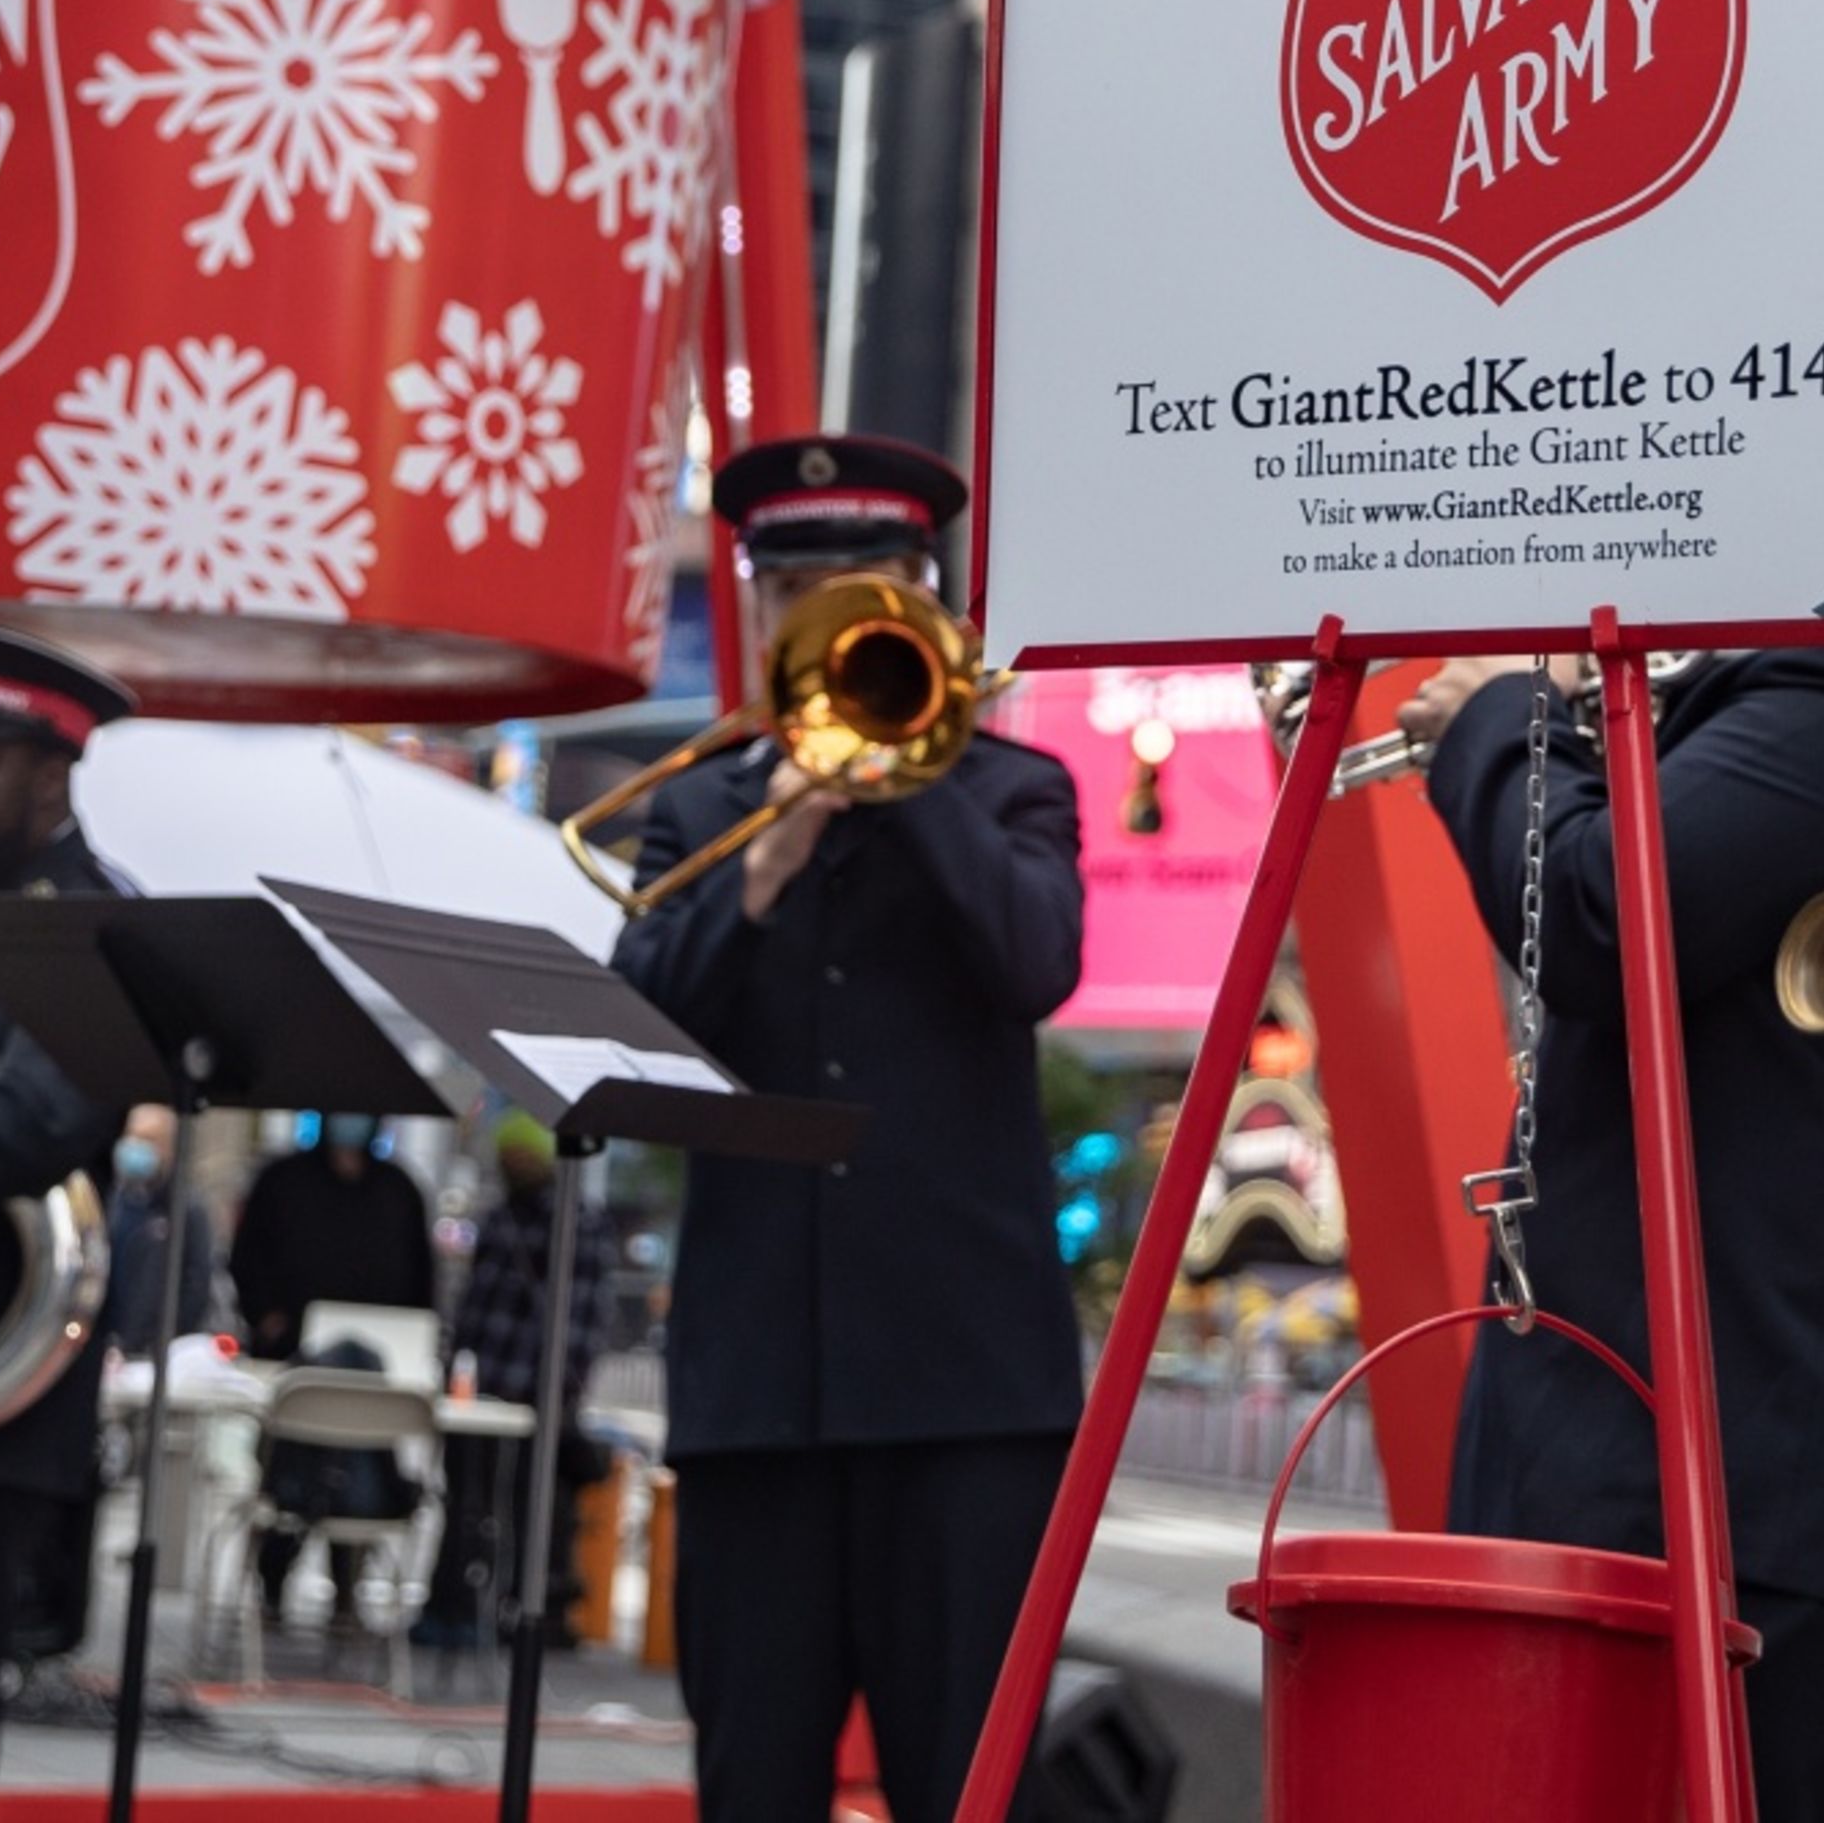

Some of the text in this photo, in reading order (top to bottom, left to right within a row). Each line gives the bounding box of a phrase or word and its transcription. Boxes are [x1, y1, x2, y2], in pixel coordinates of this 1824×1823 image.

[1116, 380, 1217, 436] Text
[1231, 349, 1647, 429] GiantRedKettle
[1664, 362, 1715, 403] to
[1254, 417, 1746, 479] to illuminate the Giant Kettle
[1298, 482, 1704, 526] Visit www.GiantRedKettle.org
[1283, 529, 1718, 574] to make a donation from anywhere
